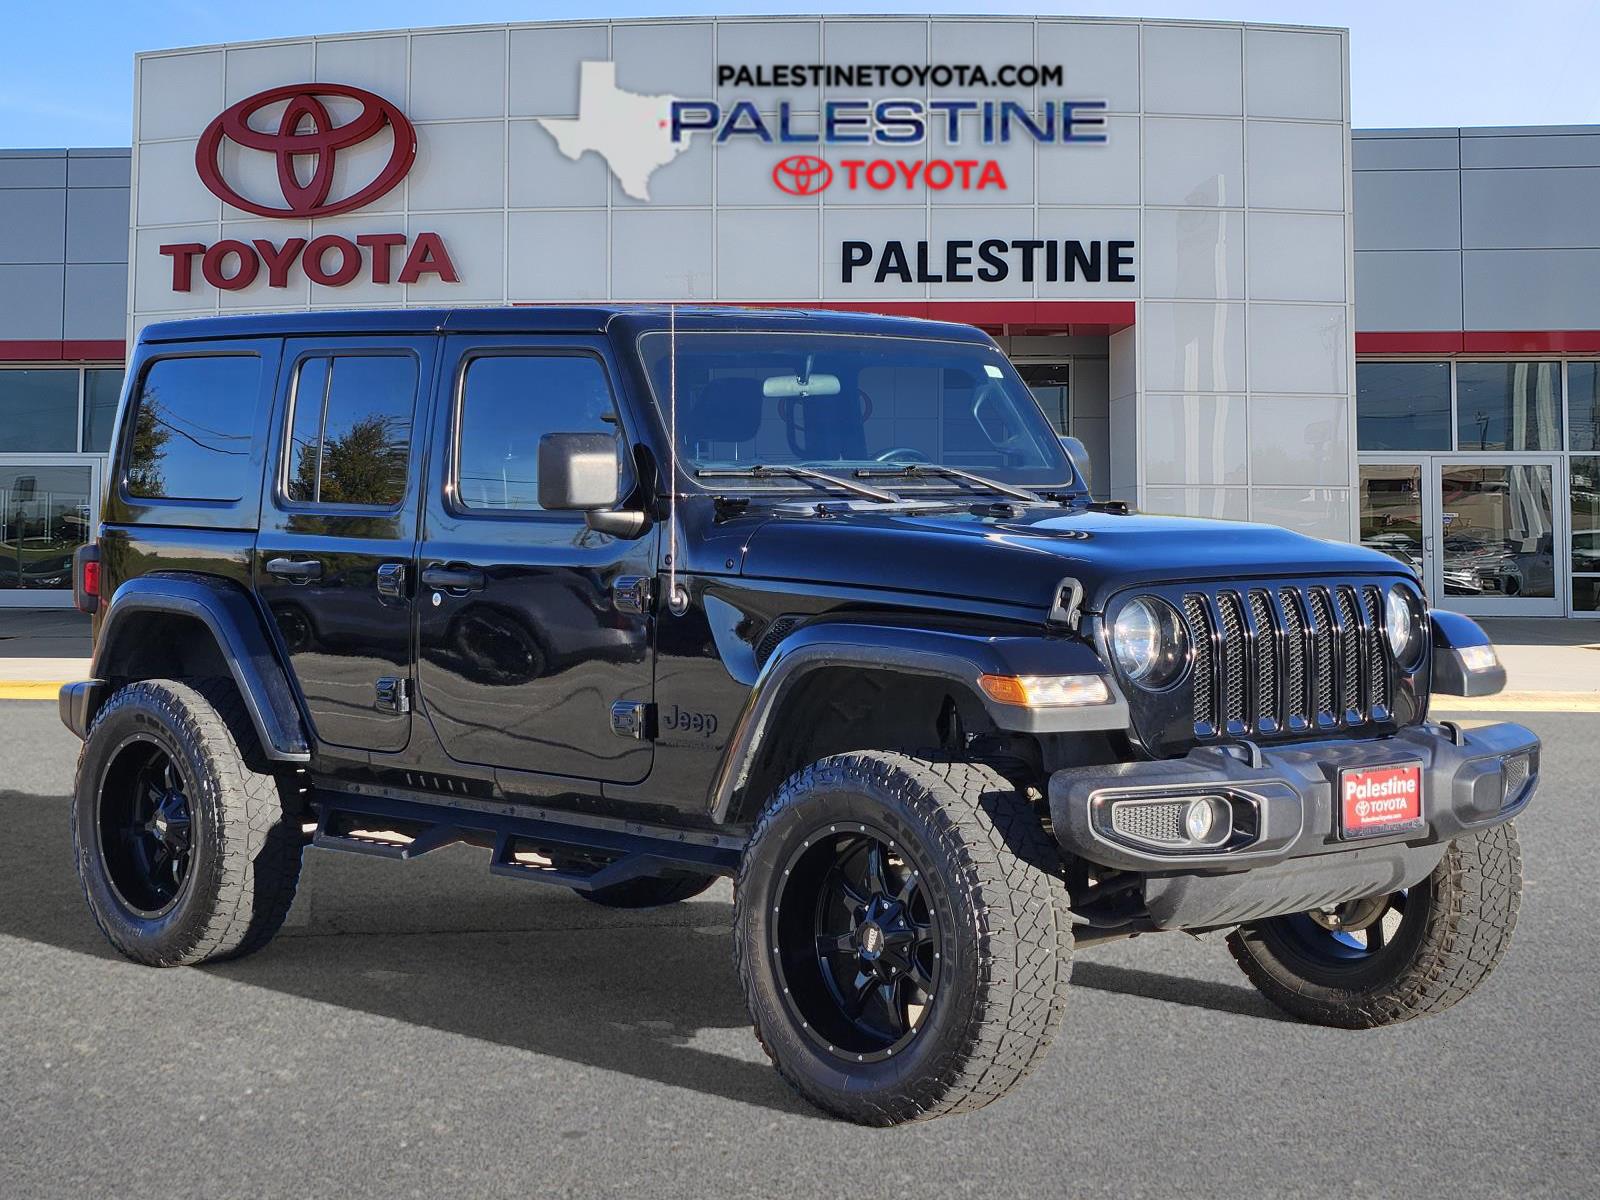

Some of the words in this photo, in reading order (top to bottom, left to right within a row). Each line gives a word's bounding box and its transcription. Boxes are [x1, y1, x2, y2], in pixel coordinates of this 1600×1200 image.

[159, 232, 461, 293] TOYOTA
[841, 239, 1136, 284] PALESTINE
[663, 704, 718, 738] Jeep
[1346, 775, 1416, 801] Palestine
[1370, 797, 1408, 813] TOYOTA
